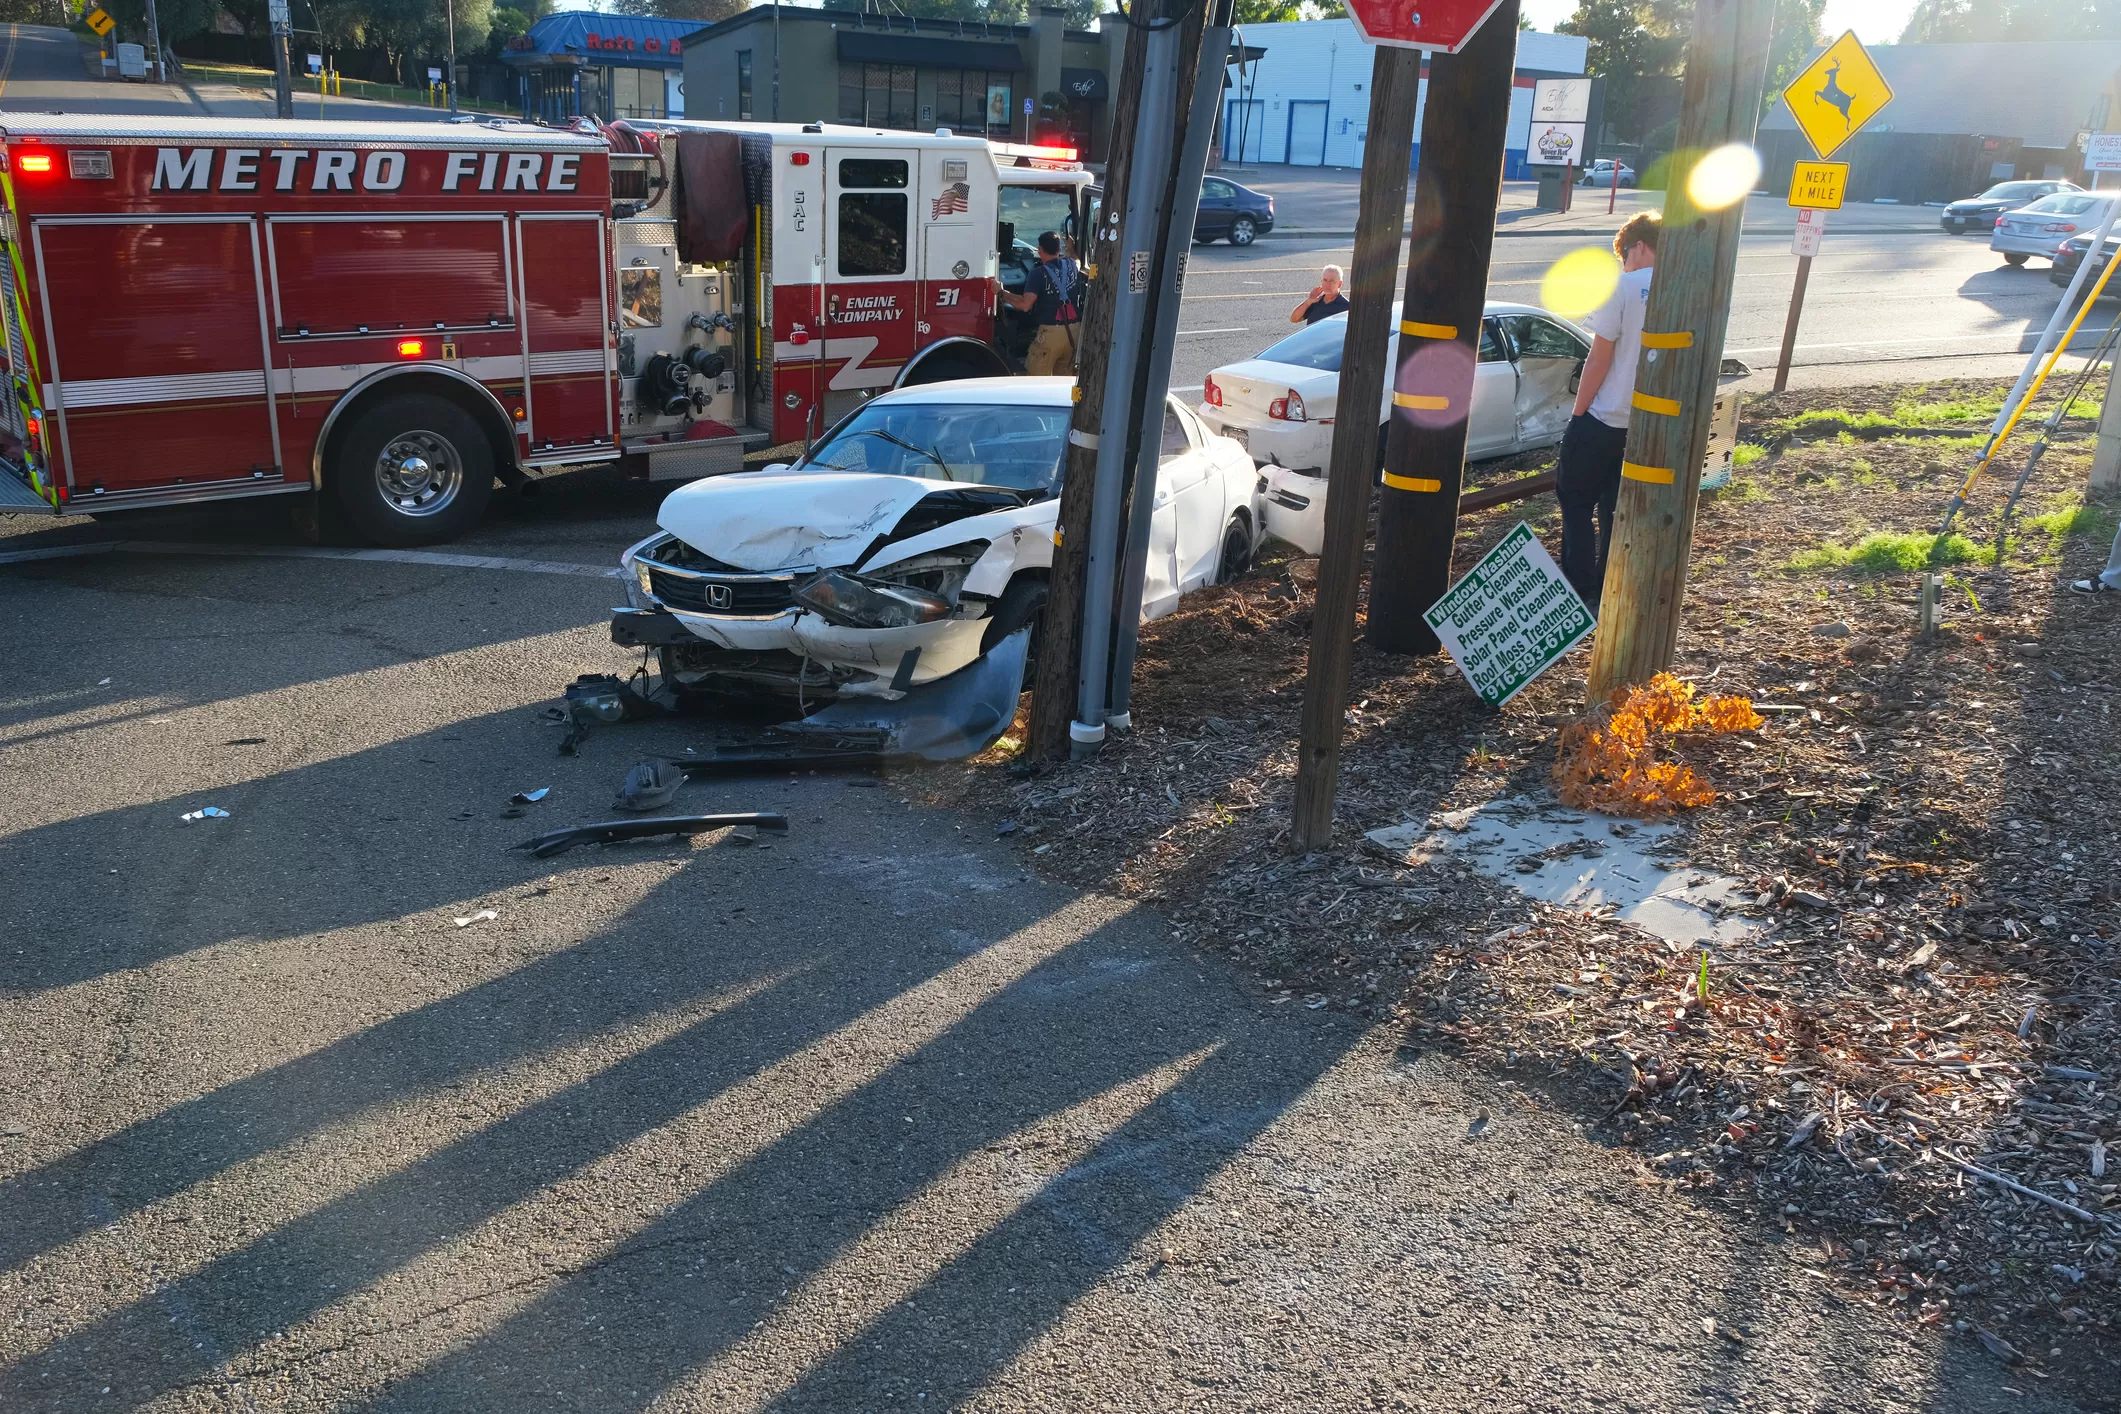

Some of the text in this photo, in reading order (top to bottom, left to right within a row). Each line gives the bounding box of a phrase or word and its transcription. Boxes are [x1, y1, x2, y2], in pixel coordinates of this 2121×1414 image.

[587, 33, 636, 51] Raft
[151, 148, 581, 194] METRO FIRE
[1805, 171, 1834, 183] NEXT
[1799, 187, 1835, 200] 1 MILE
[793, 190, 806, 232] SAC
[1799, 210, 1811, 222] NO
[1797, 224, 1822, 236] STOPPING
[846, 295, 897, 309] ENGINE
[936, 288, 961, 306] 31
[837, 309, 904, 323] COMPANY
[1431, 533, 1528, 623] Window Washing
[1452, 555, 1531, 629] Gutter Cleaning
[1457, 567, 1548, 650] Pressure Washing
[1462, 643, 1492, 671] Solar
[1488, 615, 1521, 649] Panel
[1517, 578, 1567, 623] Cleaning
[1471, 659, 1499, 689] Roof
[1495, 640, 1526, 669] Moss
[1521, 591, 1579, 645] Treatment
[1486, 610, 1585, 699] 916-993-6799
